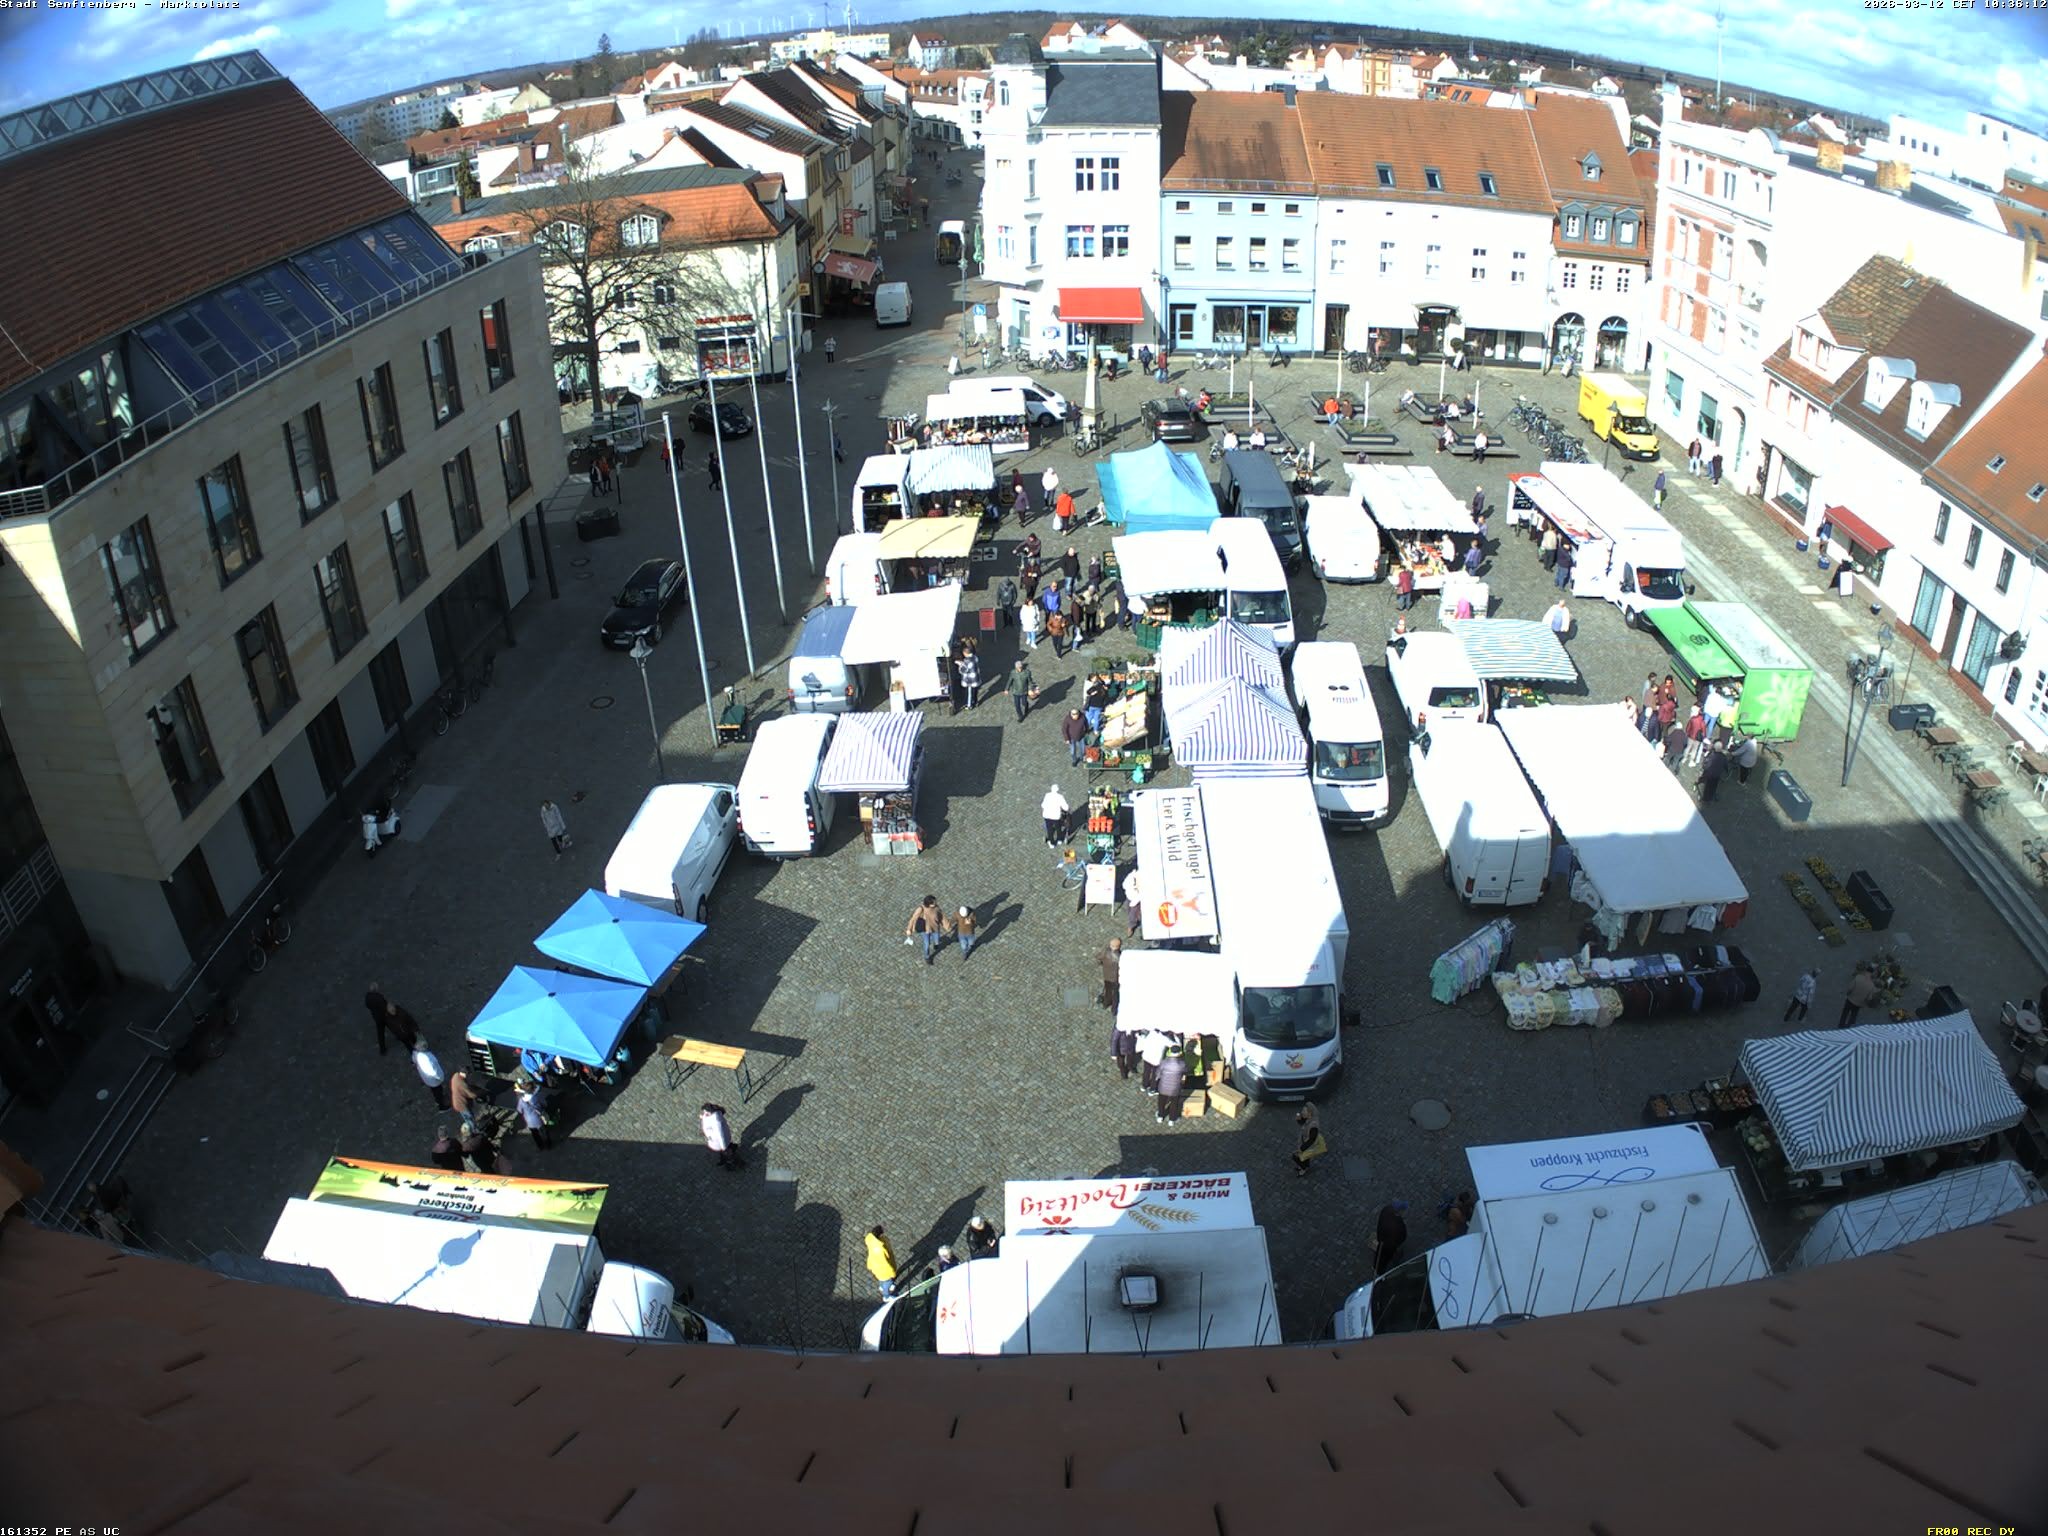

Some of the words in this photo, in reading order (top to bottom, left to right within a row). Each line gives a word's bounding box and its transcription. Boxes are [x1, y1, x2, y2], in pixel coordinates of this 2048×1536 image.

[1162, 796, 1176, 820] Eier
[1167, 834, 1182, 861] Wild
[1529, 1151, 1584, 1168] Kroppen
[1584, 1145, 1649, 1164] Fischzucht
[1134, 1177, 1231, 1192] BÄCKEREI
[1167, 1192, 1178, 1201] &
[1182, 1189, 1230, 1200] Mühle
[418, 1197, 485, 1215] Fleischerei
